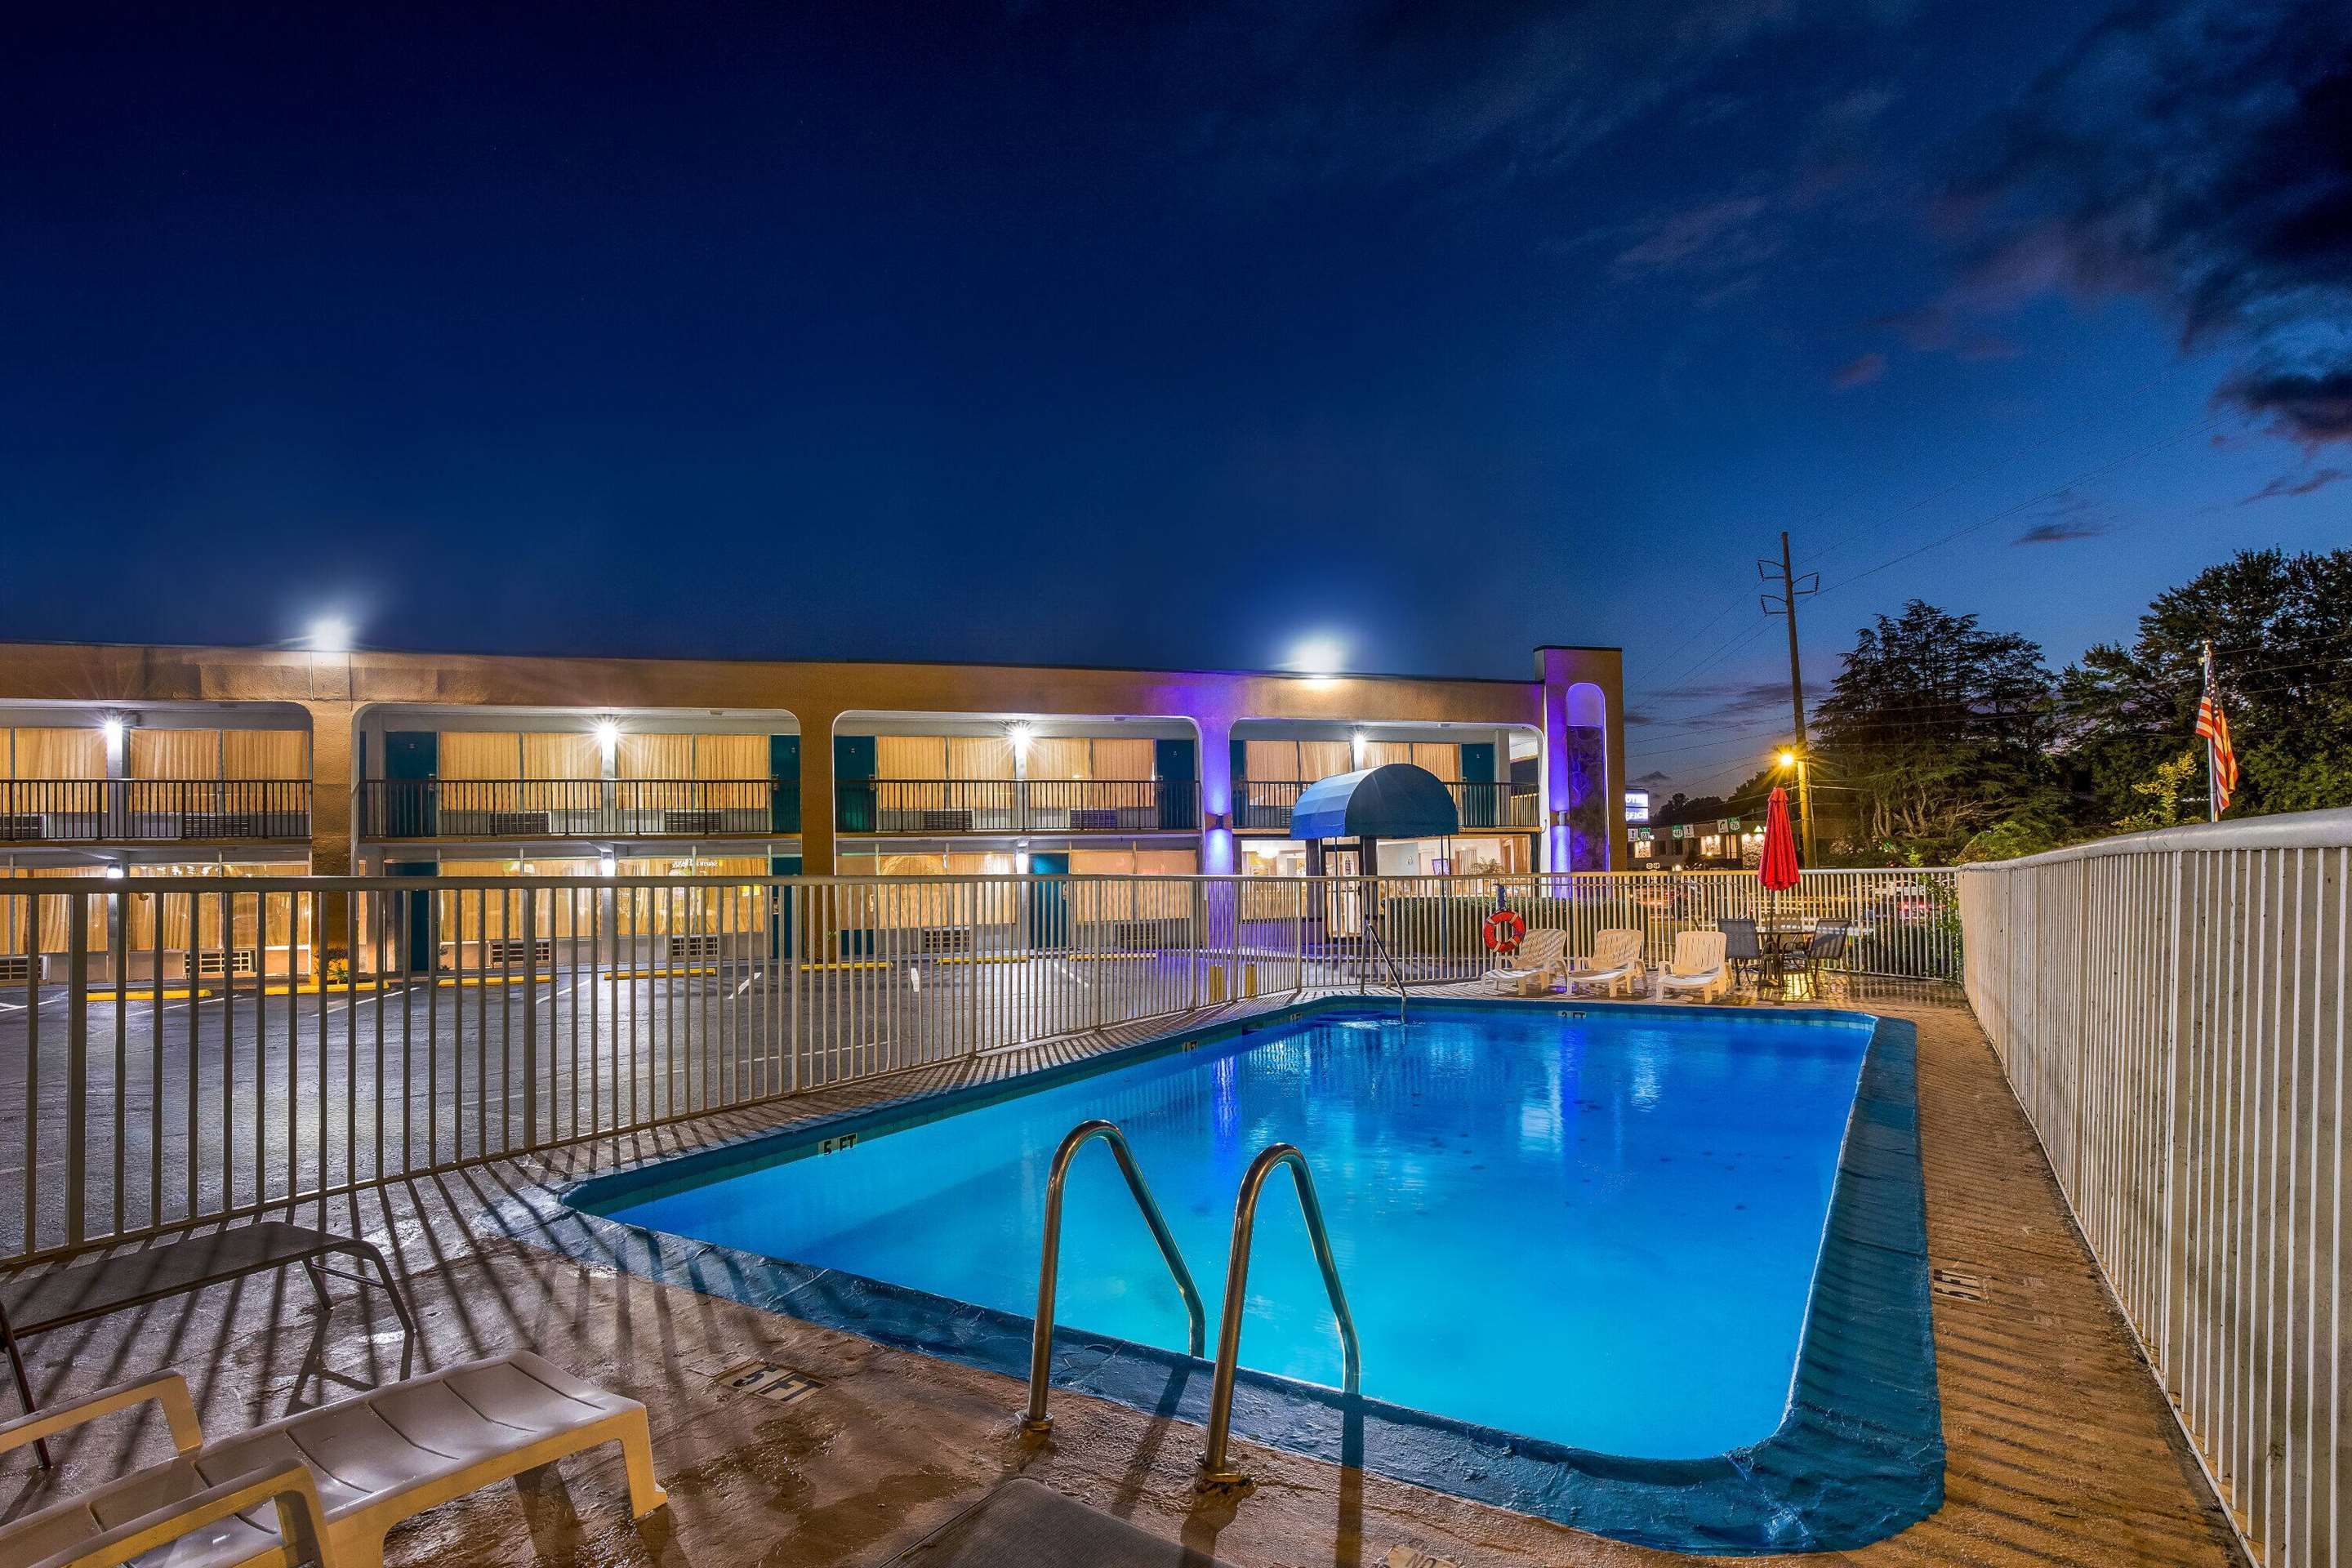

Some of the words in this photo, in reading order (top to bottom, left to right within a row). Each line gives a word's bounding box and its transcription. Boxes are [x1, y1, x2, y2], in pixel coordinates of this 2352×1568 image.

[823, 1140, 832, 1156] 5
[839, 1134, 857, 1151] FT
[732, 1363, 778, 1388] 5
[758, 1372, 827, 1402] FT
